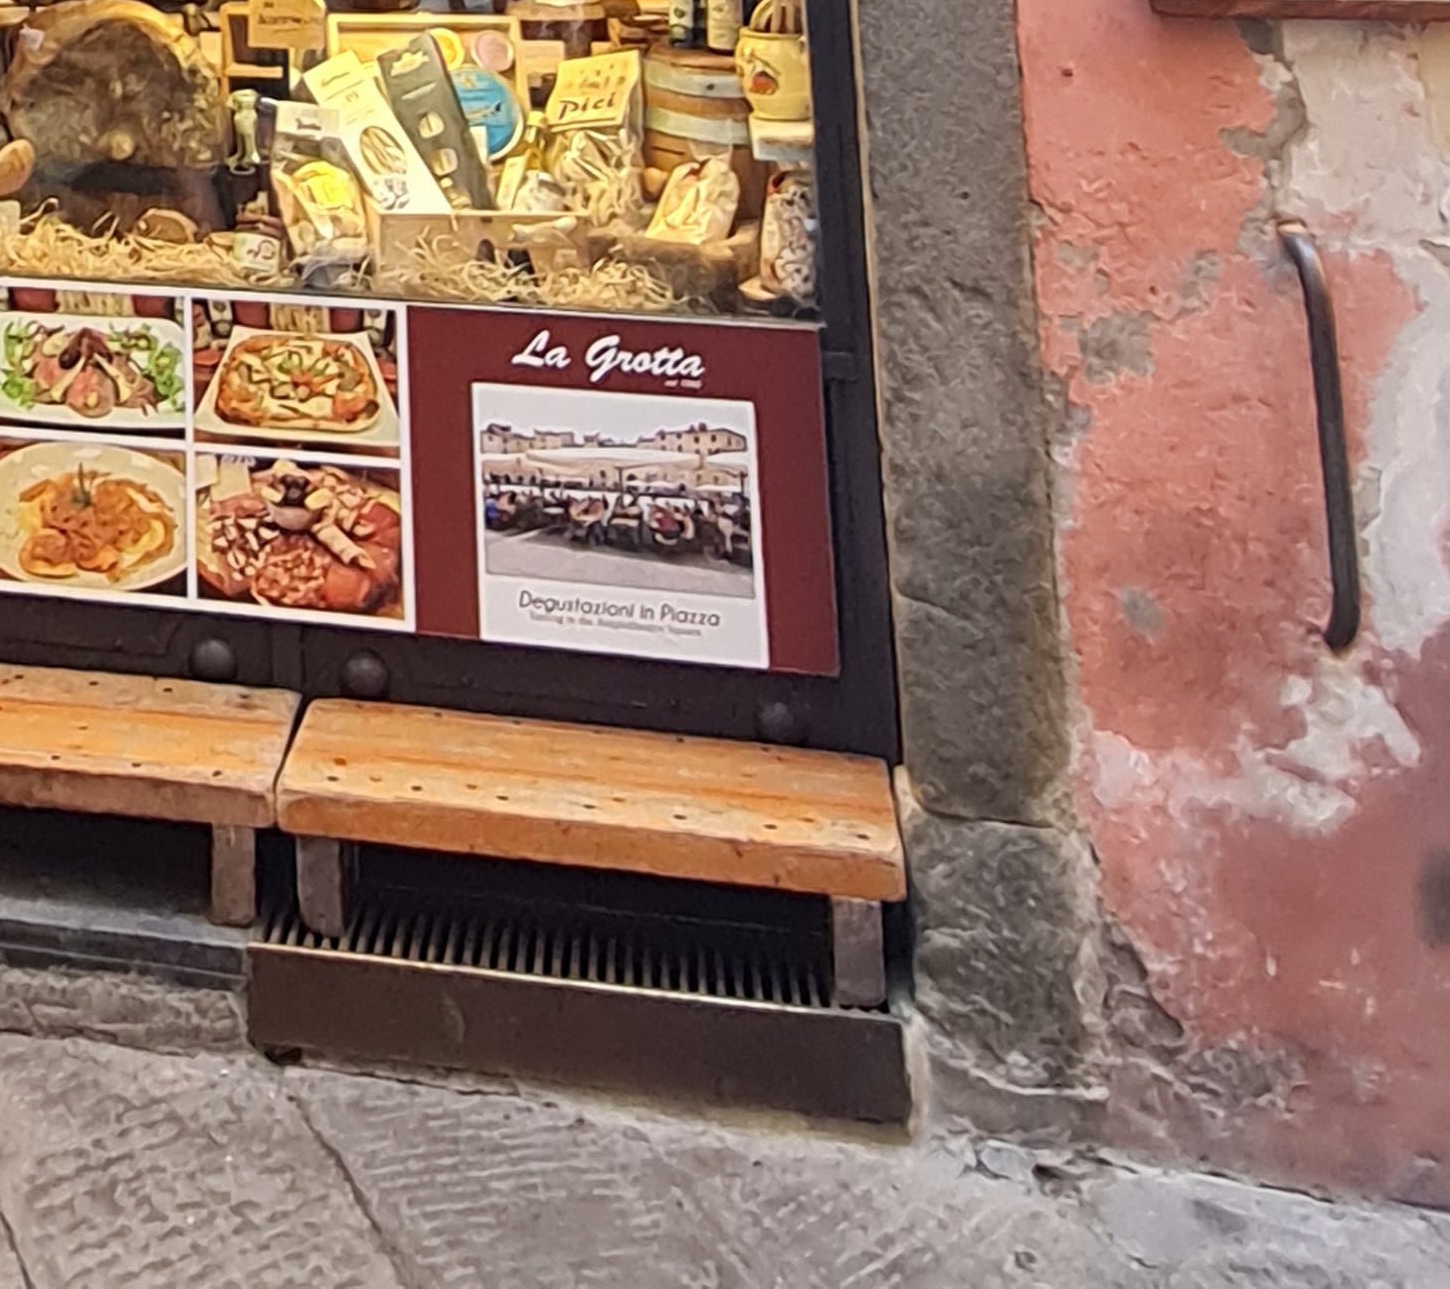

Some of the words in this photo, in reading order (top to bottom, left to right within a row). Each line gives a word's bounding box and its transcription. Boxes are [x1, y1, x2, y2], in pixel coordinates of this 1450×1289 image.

[511, 329, 571, 368] La
[585, 334, 705, 383] Grotta
[519, 590, 635, 617] Degustazioni
[660, 603, 720, 626] Piazza
